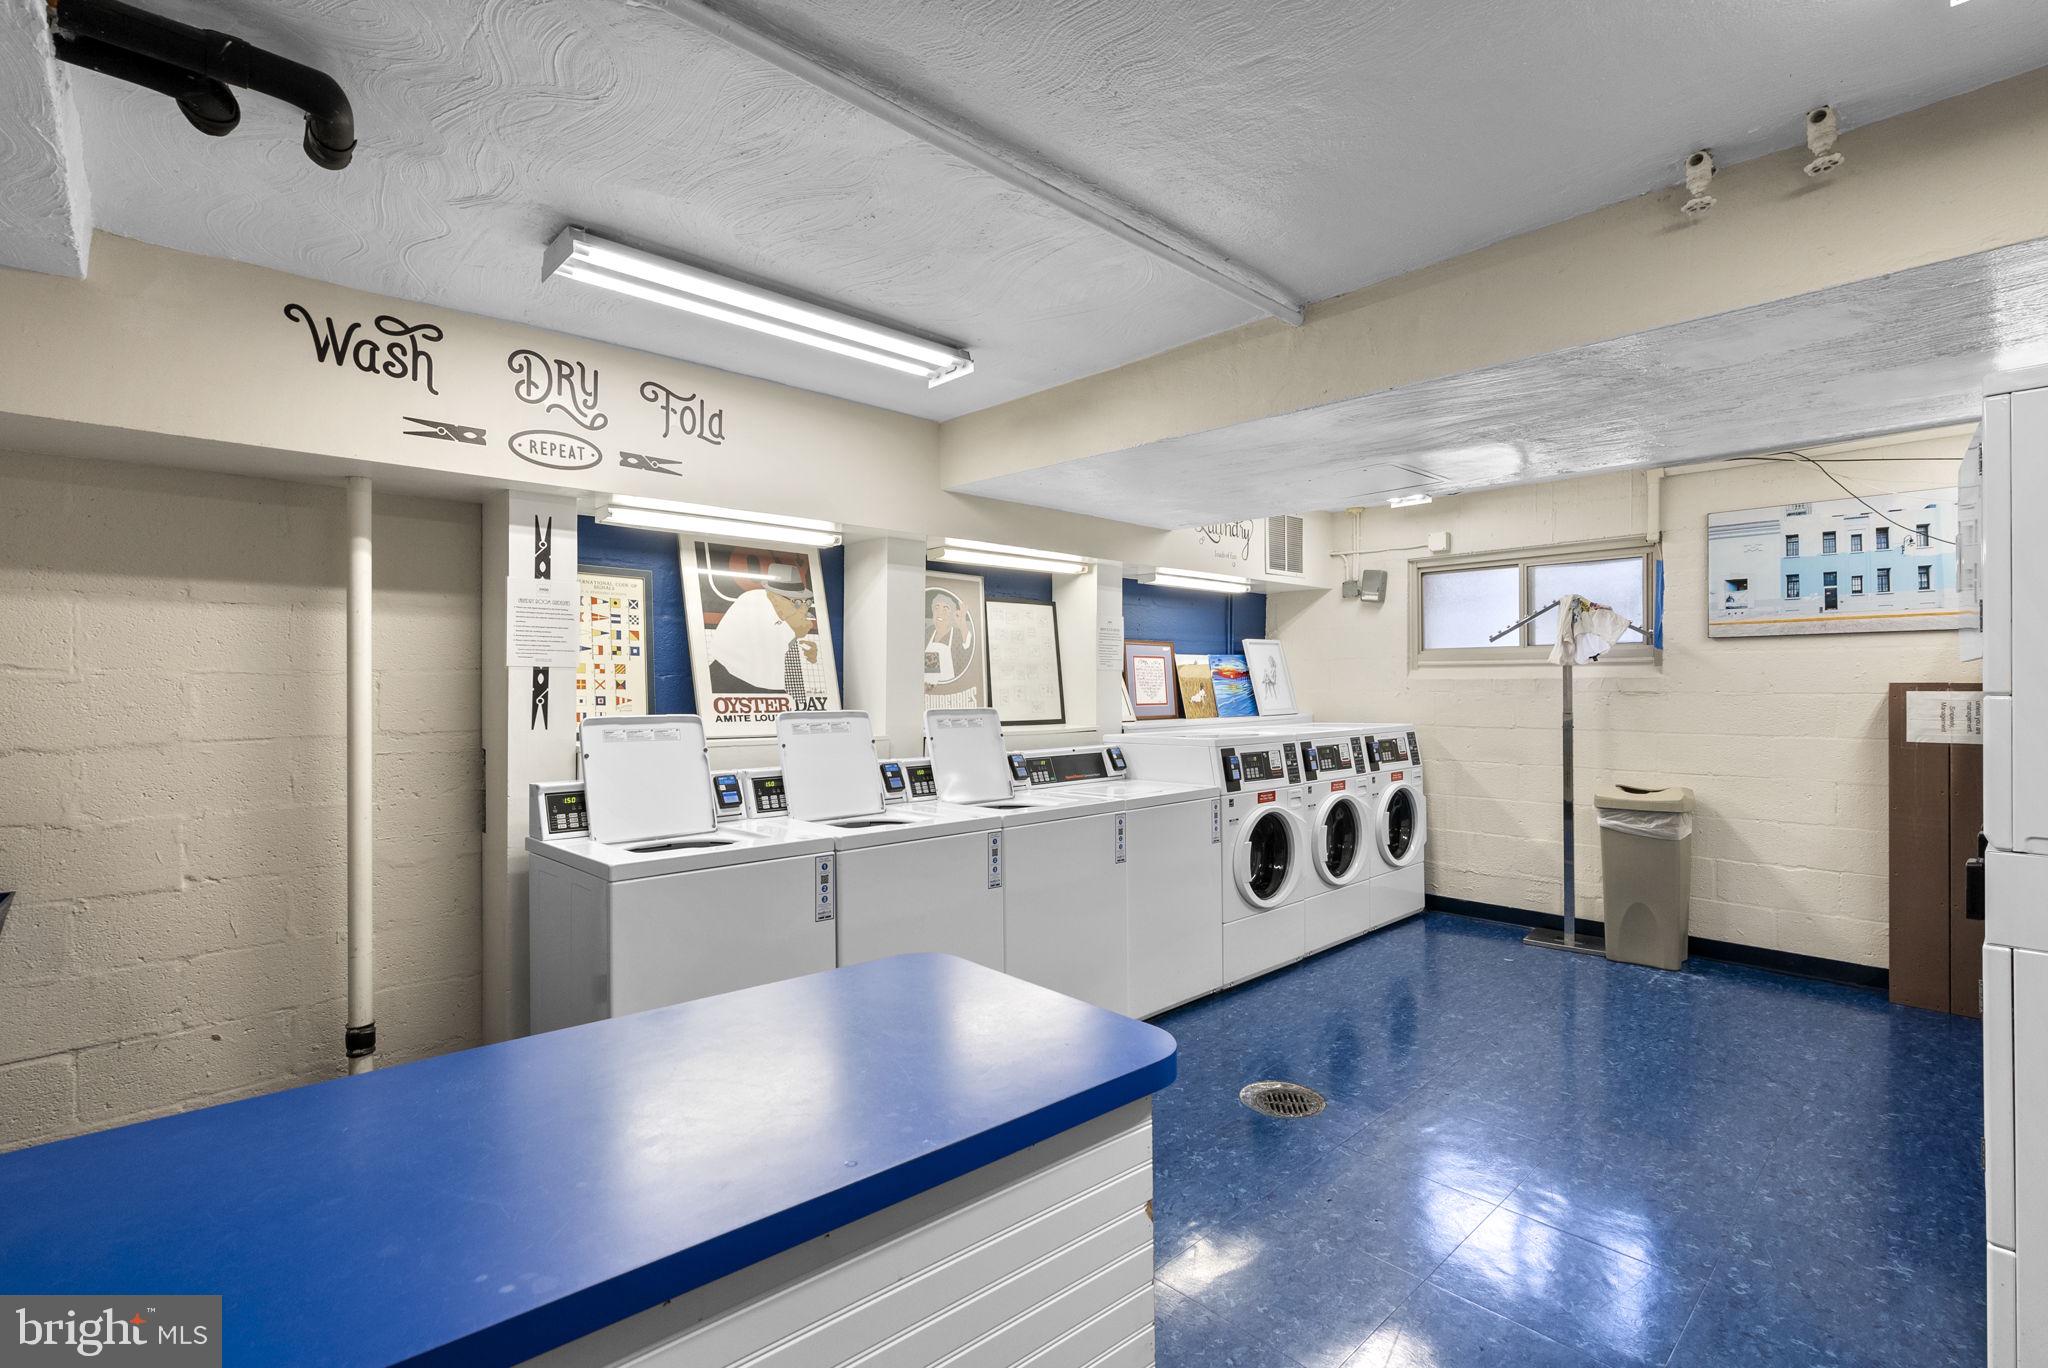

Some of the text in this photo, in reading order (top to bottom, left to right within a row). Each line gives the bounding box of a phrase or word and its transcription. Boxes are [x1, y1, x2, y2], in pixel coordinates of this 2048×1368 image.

[283, 303, 443, 396] Wash
[640, 381, 725, 445] Fold
[529, 439, 585, 461] REPEAT
[713, 696, 828, 715] OYSTER DAY
[715, 713, 778, 723] AMITE LOU
